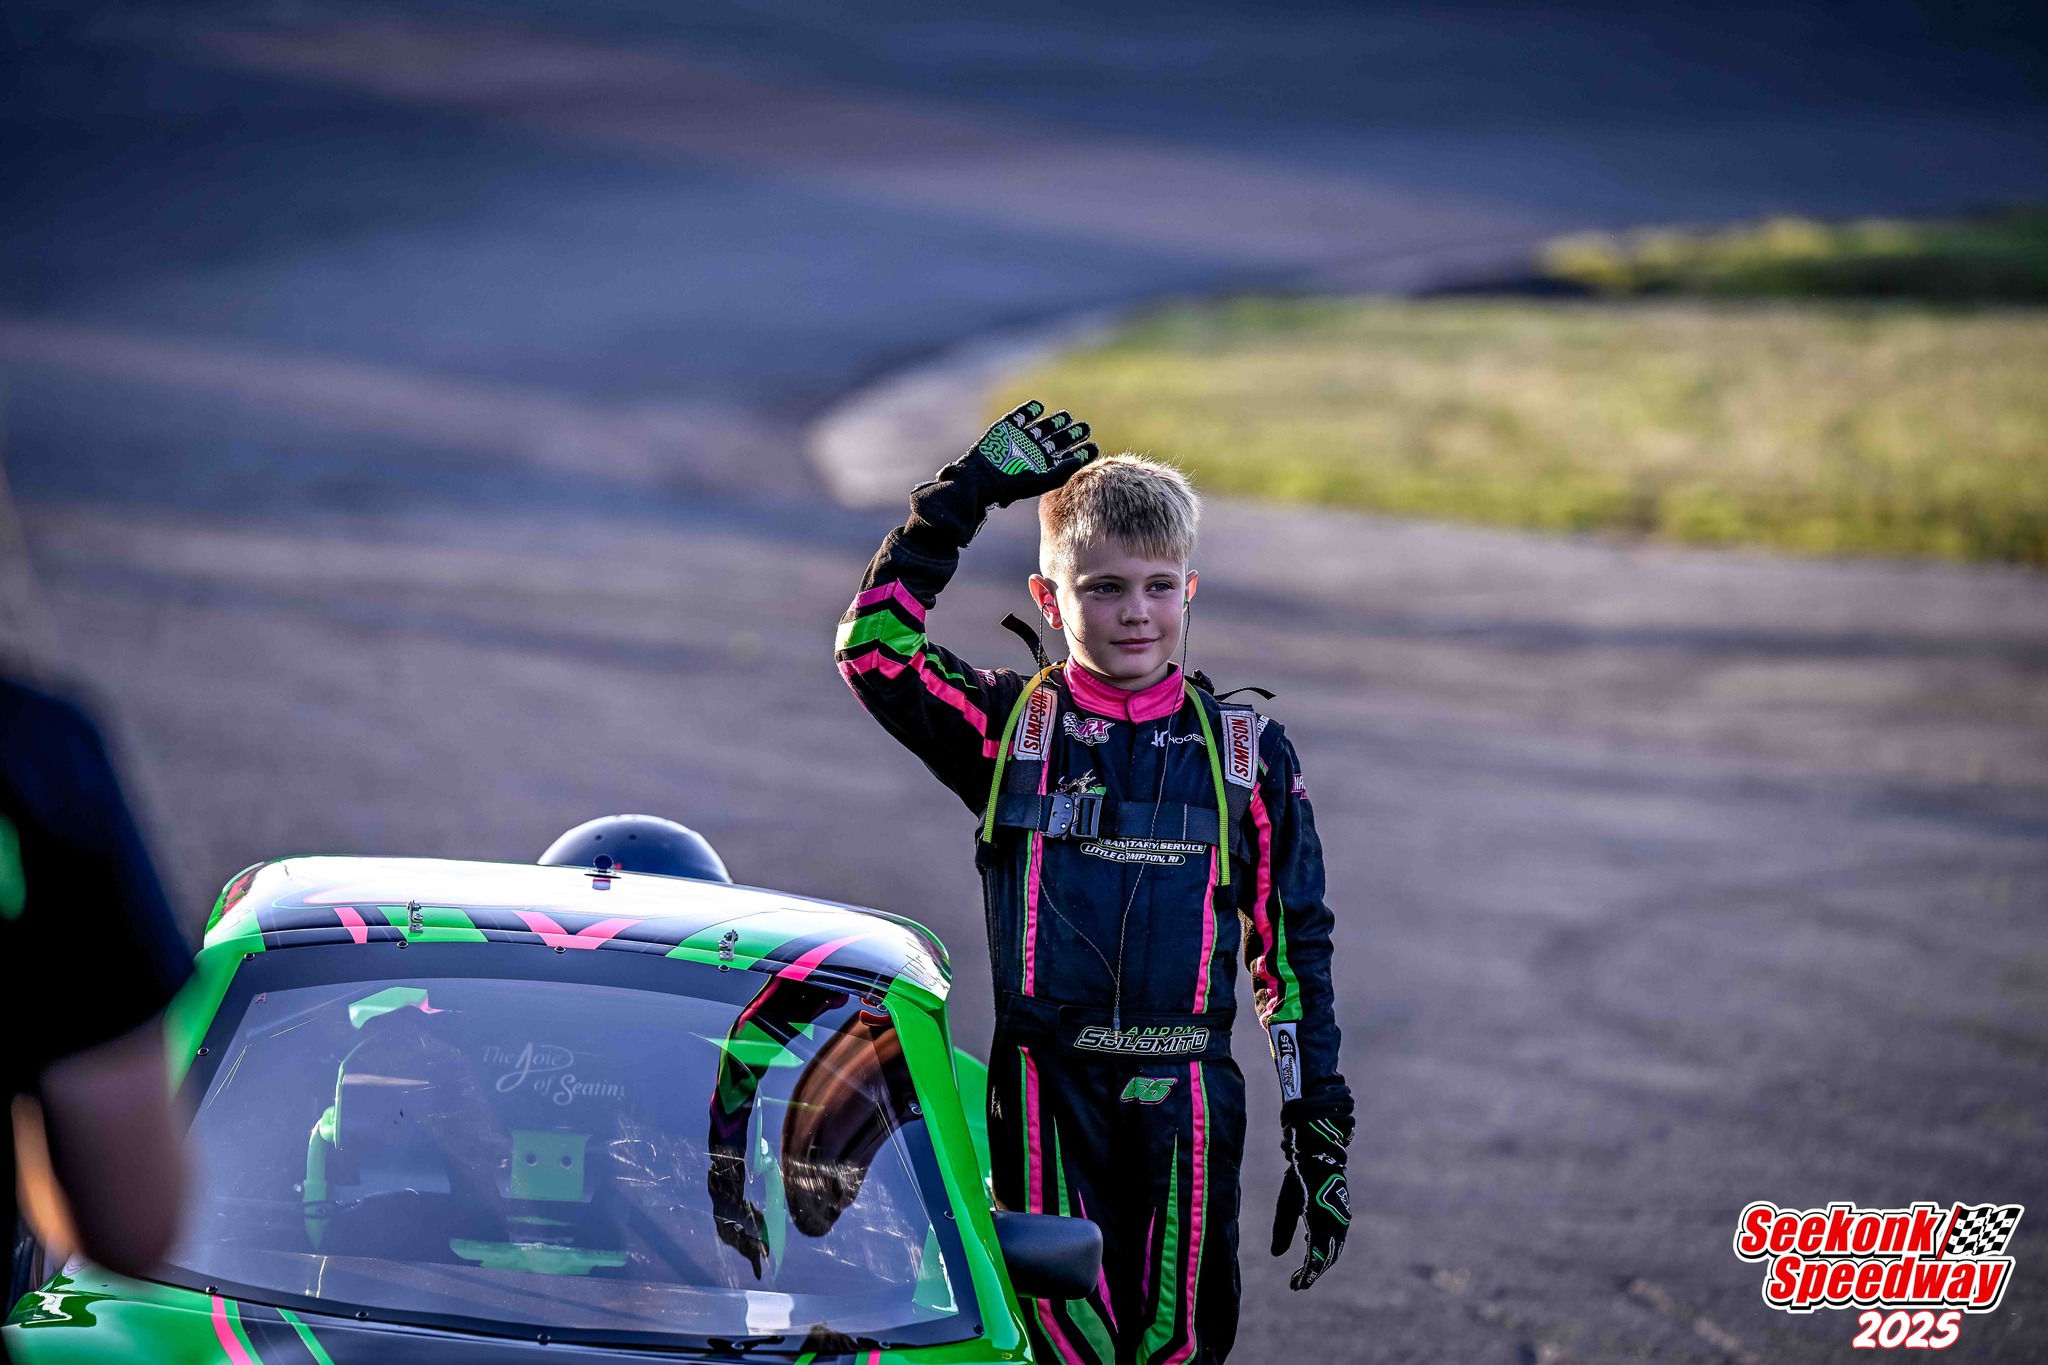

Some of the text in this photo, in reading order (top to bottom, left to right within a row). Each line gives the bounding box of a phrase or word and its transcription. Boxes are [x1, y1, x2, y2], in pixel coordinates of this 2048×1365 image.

[1024, 691, 1048, 751] SIMPSON
[1231, 718, 1249, 778] SIMPSON
[1084, 844, 1116, 859] LITTLE
[1167, 855, 1180, 864] RI
[1103, 838, 1204, 852] SANITARY SERVICE
[1077, 1027, 1209, 1054] SOLOMITO
[482, 1045, 515, 1065] The
[533, 1074, 556, 1097] of
